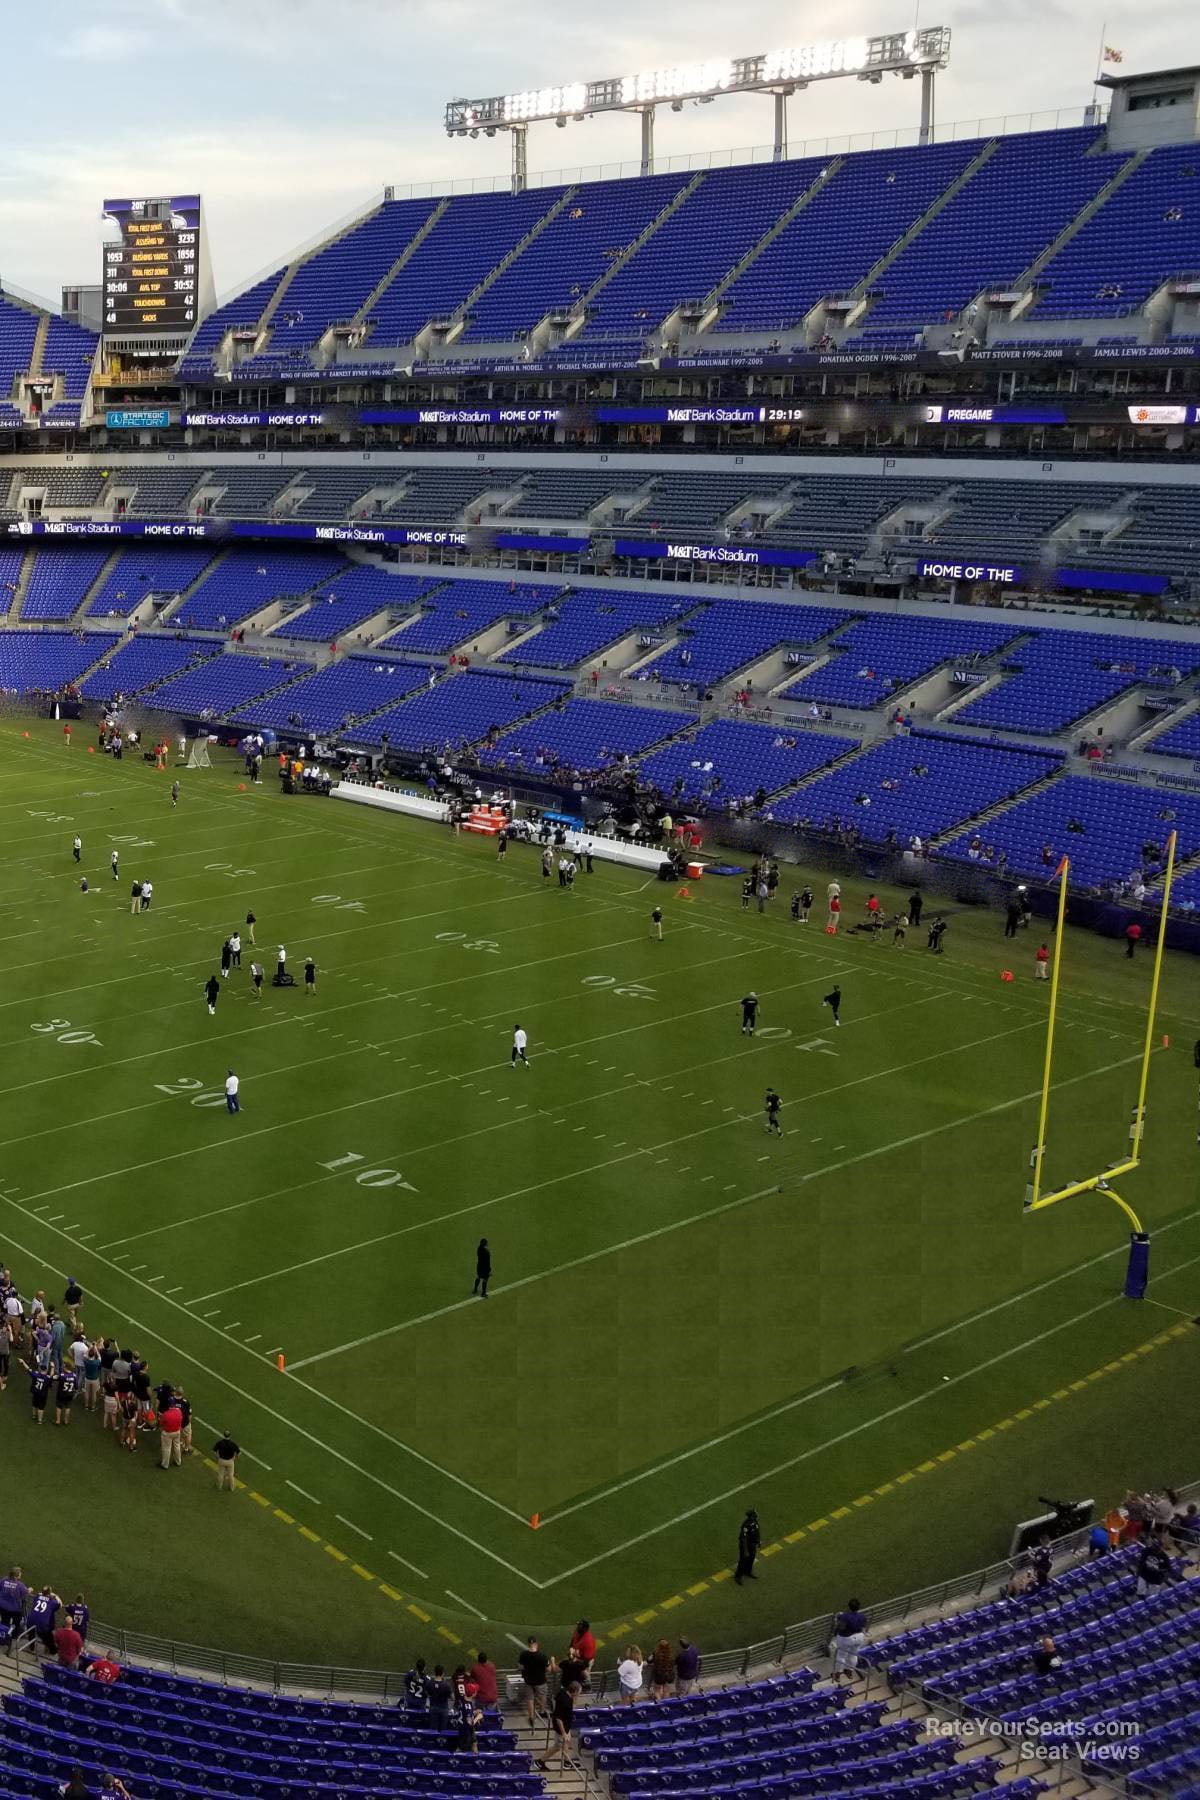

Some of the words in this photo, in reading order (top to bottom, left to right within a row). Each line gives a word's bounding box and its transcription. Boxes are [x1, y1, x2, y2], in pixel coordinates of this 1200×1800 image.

[107, 268, 117, 278] 311
[183, 264, 194, 275] 311
[106, 297, 115, 308] 51
[183, 295, 194, 305] 42
[184, 310, 194, 320] 41
[992, 351, 1021, 359] STOVER
[1094, 349, 1121, 357] JAMAL
[1149, 347, 1195, 355] 2000-2006
[819, 355, 853, 364] JONATHAN
[855, 355, 879, 363] OGDEN
[881, 354, 917, 362] 1996-2007
[187, 415, 207, 424] M&T
[208, 415, 227, 424] Bank
[228, 415, 259, 424] Stadium
[419, 411, 439, 422] M&T
[440, 412, 458, 422] Bank
[459, 411, 490, 422] Stadium
[500, 410, 526, 421] HOME
[528, 410, 541, 420] OF
[668, 409, 691, 420] M&T
[692, 409, 714, 420] Bank
[716, 409, 754, 420] Stadium
[769, 409, 801, 419] 29:19
[948, 409, 992, 420] PREGAME
[269, 416, 294, 424] HOME
[295, 416, 308, 424] OF
[45, 523, 66, 533] M&T
[67, 523, 87, 532] Bank
[87, 523, 121, 533] Stadium
[144, 525, 171, 535] HOME
[173, 526, 186, 534] OF
[187, 526, 205, 535] THE
[316, 528, 335, 538] M&T
[335, 529, 353, 539] Bank
[353, 529, 384, 541] Stadium
[407, 532, 433, 542] HOME
[435, 533, 447, 542] OF
[449, 533, 466, 543] THE
[667, 545, 691, 558] M&T
[692, 547, 717, 559] Bank
[718, 549, 758, 562] Stadium
[923, 563, 963, 577] HOME
[965, 566, 984, 579] OF
[987, 569, 1014, 581] THE
[204, 863, 257, 877] 50
[30, 1018, 97, 1044] 30
[316, 1151, 402, 1187] 10
[34, 1600, 48, 1613] 29
[73, 1615, 84, 1626] 57
[409, 1681, 424, 1698] 52
